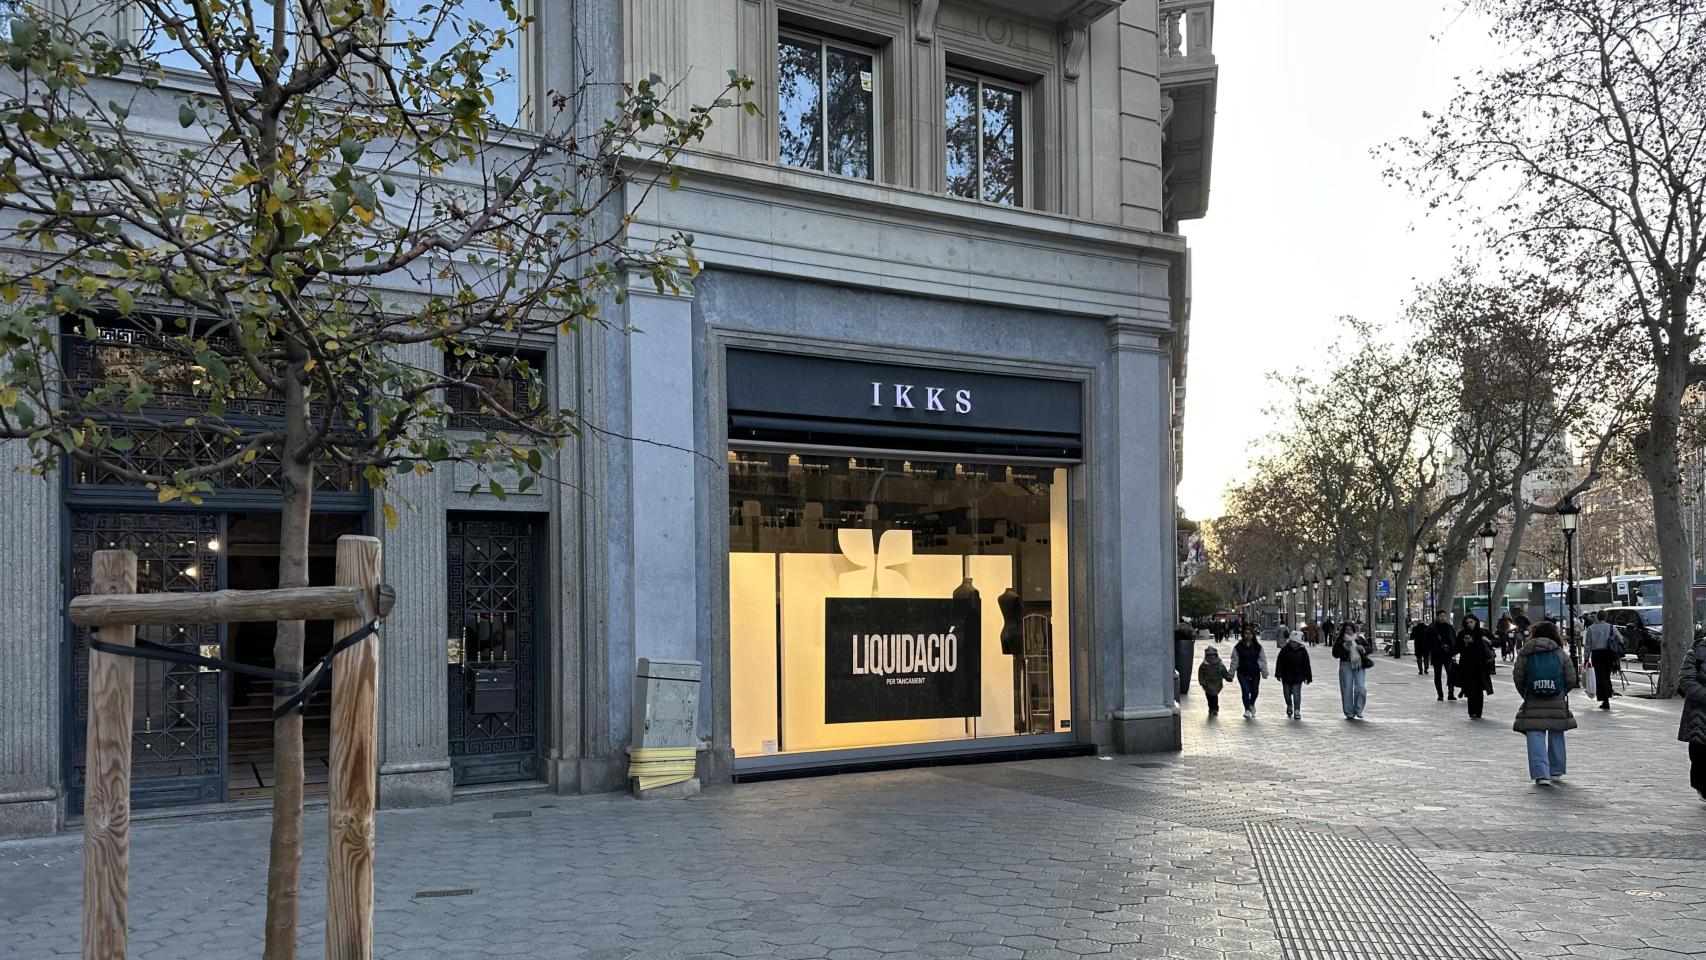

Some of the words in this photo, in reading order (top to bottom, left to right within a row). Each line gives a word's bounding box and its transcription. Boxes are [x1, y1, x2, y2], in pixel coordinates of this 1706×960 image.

[871, 381, 972, 414] IKKS
[852, 626, 958, 677] LIQUIDACIÓ
[896, 677, 926, 685] TANCAMENT
[1533, 680, 1556, 689] PUMA
